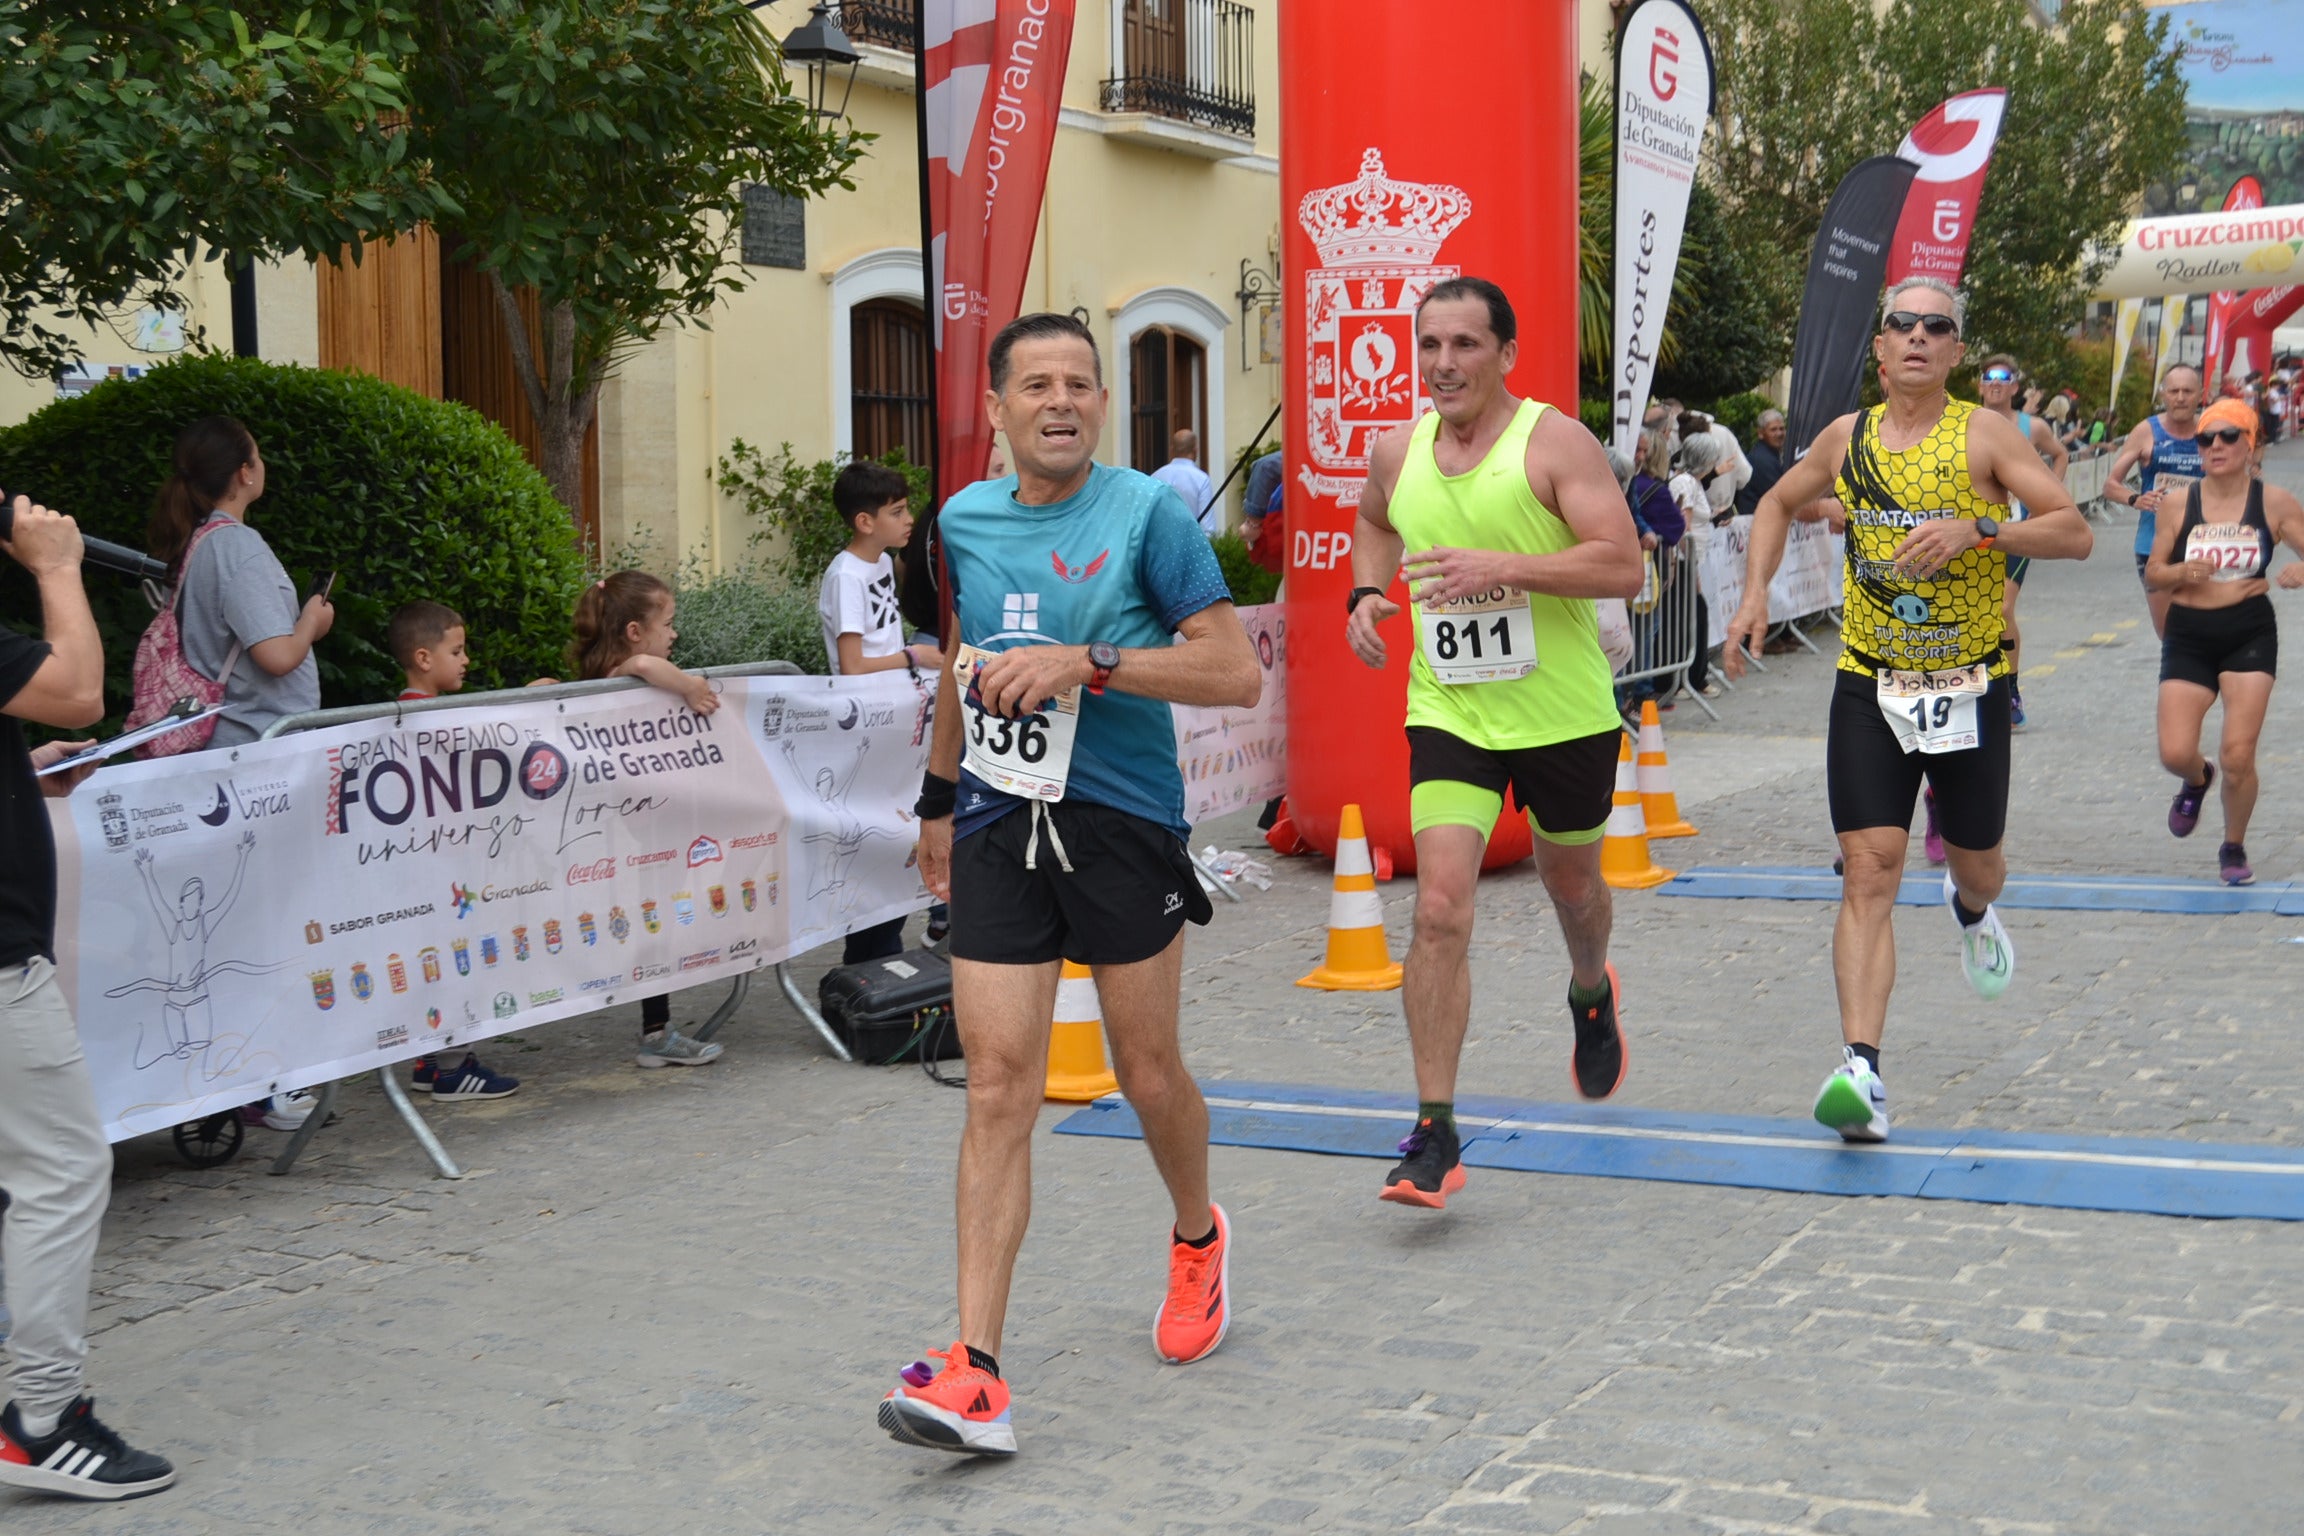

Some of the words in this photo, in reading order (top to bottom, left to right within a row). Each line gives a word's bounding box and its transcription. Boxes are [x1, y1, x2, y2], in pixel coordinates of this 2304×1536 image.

[1625, 91, 1695, 138] Diputación
[1624, 120, 1641, 143] de
[1642, 127, 1694, 164] Granada
[1828, 244, 1848, 260] that
[1831, 227, 1880, 255] Movement
[1824, 261, 1858, 281] inspires
[1910, 255, 1924, 268] de
[2157, 257, 2242, 286] Radler
[1436, 616, 1512, 660] 811
[1874, 626, 1893, 641] TU
[1899, 624, 1960, 642] JAMÓN
[1878, 645, 1899, 658] AL
[1903, 643, 1960, 659] CORTE
[784, 722, 796, 734] de
[796, 720, 829, 734] Granada
[786, 708, 831, 721] Diputación
[1909, 695, 1954, 733] 19
[565, 706, 713, 756] Diputación
[970, 706, 1051, 764] 336
[340, 731, 409, 771] GRAN
[417, 721, 519, 756] PREMIO
[528, 756, 560, 783] 24
[583, 755, 617, 785] de
[619, 739, 725, 777] Granada
[338, 740, 569, 835] FONDO
[130, 801, 185, 822] Diputación
[555, 762, 669, 856] Lorca
[134, 827, 149, 841] de
[149, 818, 190, 839] Granada
[626, 848, 678, 867] Cruzcampo
[481, 880, 553, 903] Granada
[328, 914, 374, 936] SABOR
[376, 901, 436, 925] GRANADA
